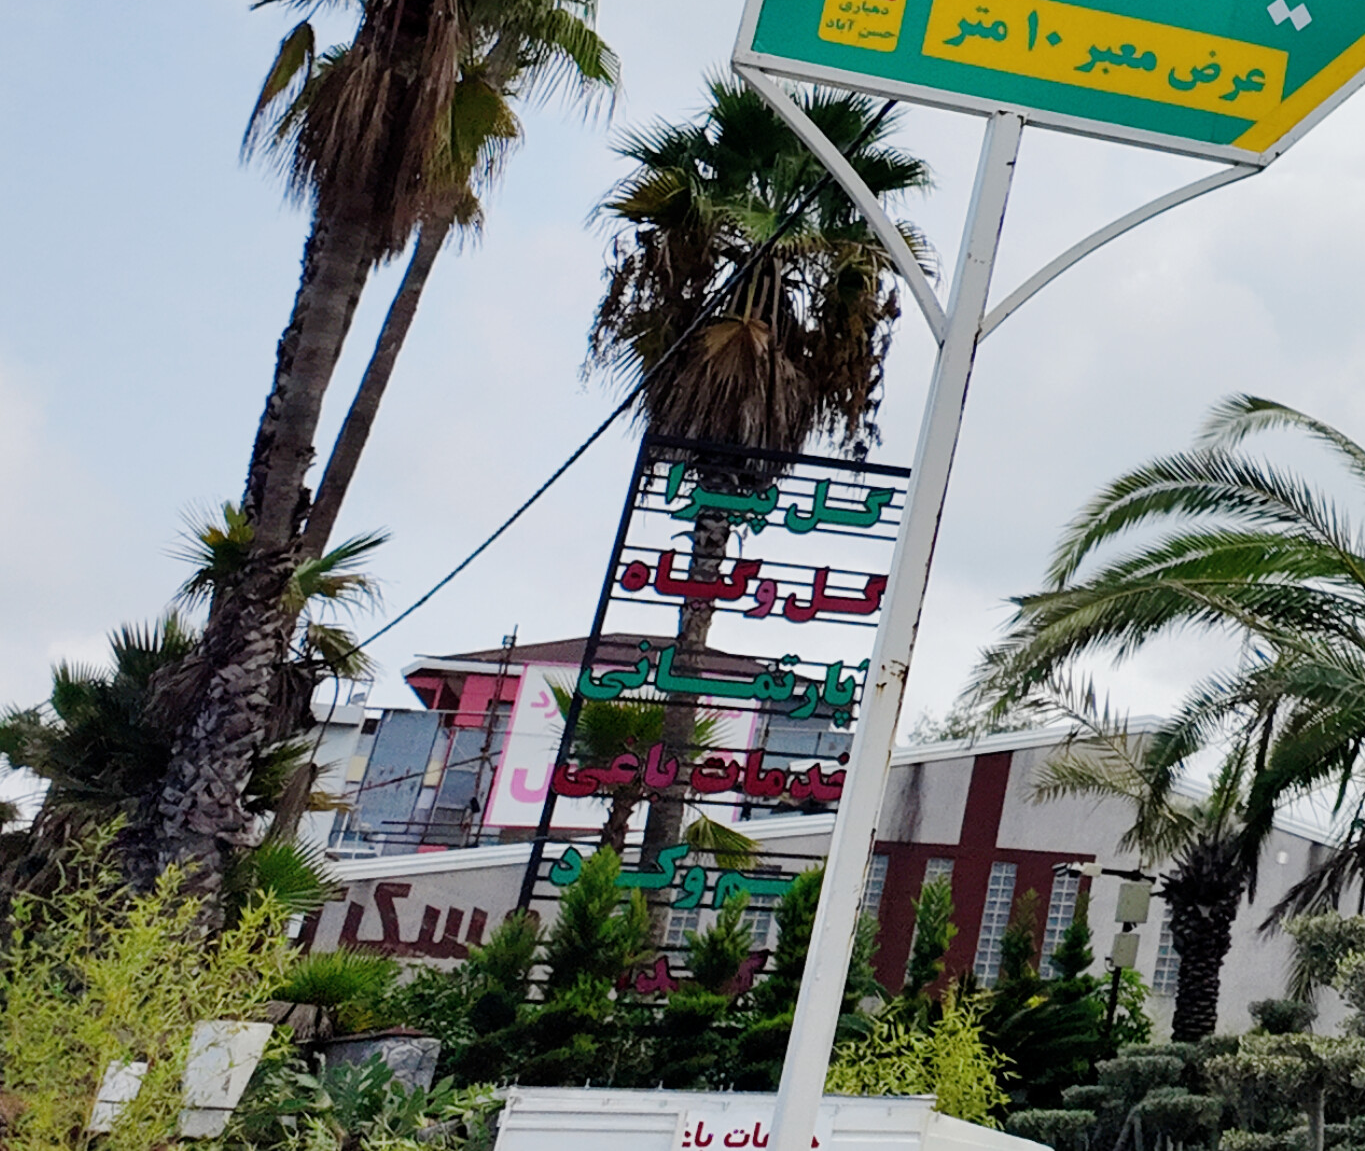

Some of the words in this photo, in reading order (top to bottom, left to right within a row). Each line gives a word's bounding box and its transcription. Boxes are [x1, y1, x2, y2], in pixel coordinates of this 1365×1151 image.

[826, 18, 854, 33] آباد
[858, 27, 896, 38] حسن
[942, 5, 1008, 47] متر
[1027, 9, 1063, 51] ۱۰
[1073, 43, 1158, 76] معبر
[1167, 49, 1267, 101] عرض
[665, 461, 779, 534] پیرا
[785, 478, 895, 534] گل
[619, 549, 762, 610] گیاه
[783, 567, 889, 622] گل
[578, 641, 870, 727] پارتمانی
